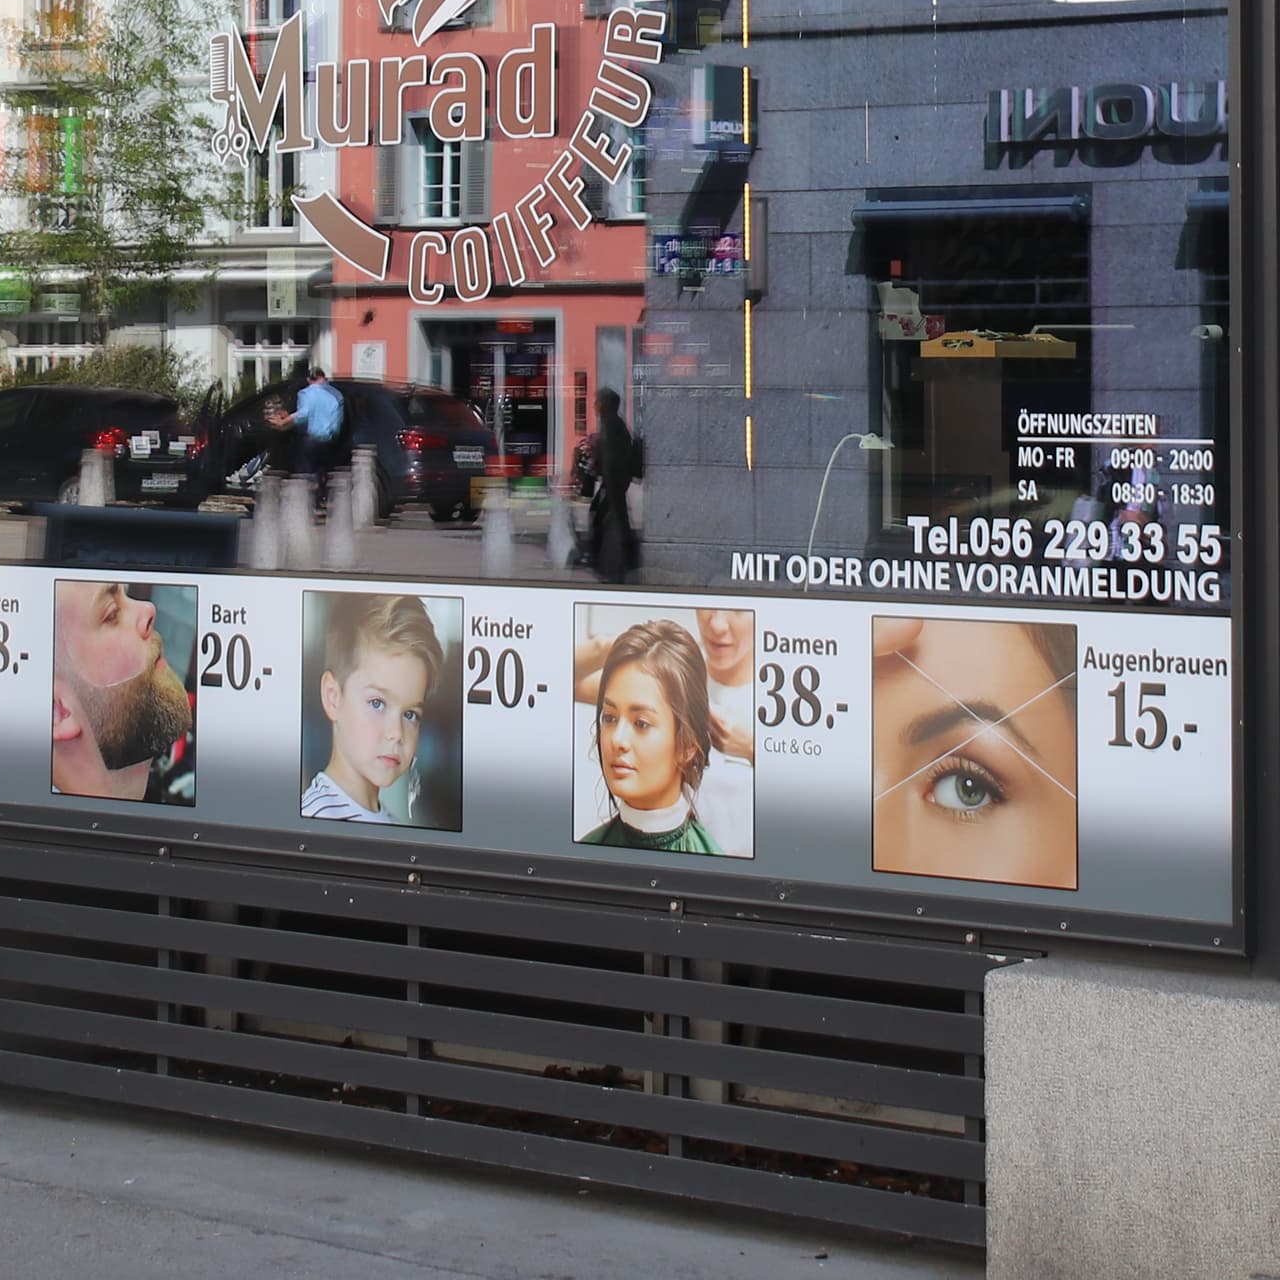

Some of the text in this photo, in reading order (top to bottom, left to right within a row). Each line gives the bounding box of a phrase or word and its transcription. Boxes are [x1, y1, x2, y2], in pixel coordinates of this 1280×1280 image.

[228, 10, 555, 153] Murad
[409, 5, 667, 304] COIFFEUR
[1018, 412, 1156, 435] ÖFFNUNGSZEITEN
[1018, 447, 1044, 467] MO
[1056, 448, 1074, 469] FR
[1111, 448, 1153, 469] 09:00
[1170, 450, 1213, 470] 20:00
[1018, 480, 1038, 501] SA
[1112, 482, 1154, 504] 08:30
[1171, 483, 1214, 505] 18:30
[907, 516, 1221, 564] Tel.056 229 33 55
[731, 553, 1220, 601] MIT ODER OHNE VORANMELDUNG
[211, 603, 247, 625] Bart
[471, 616, 533, 640] Kinder
[201, 631, 273, 691] 20.-
[763, 631, 839, 657] Damen
[1083, 646, 1229, 677] Augenbrauen
[467, 646, 548, 709] 20.-
[758, 663, 849, 730] 38.-
[1107, 680, 1198, 751] 15.-
[764, 737, 822, 757] Cut & Go
